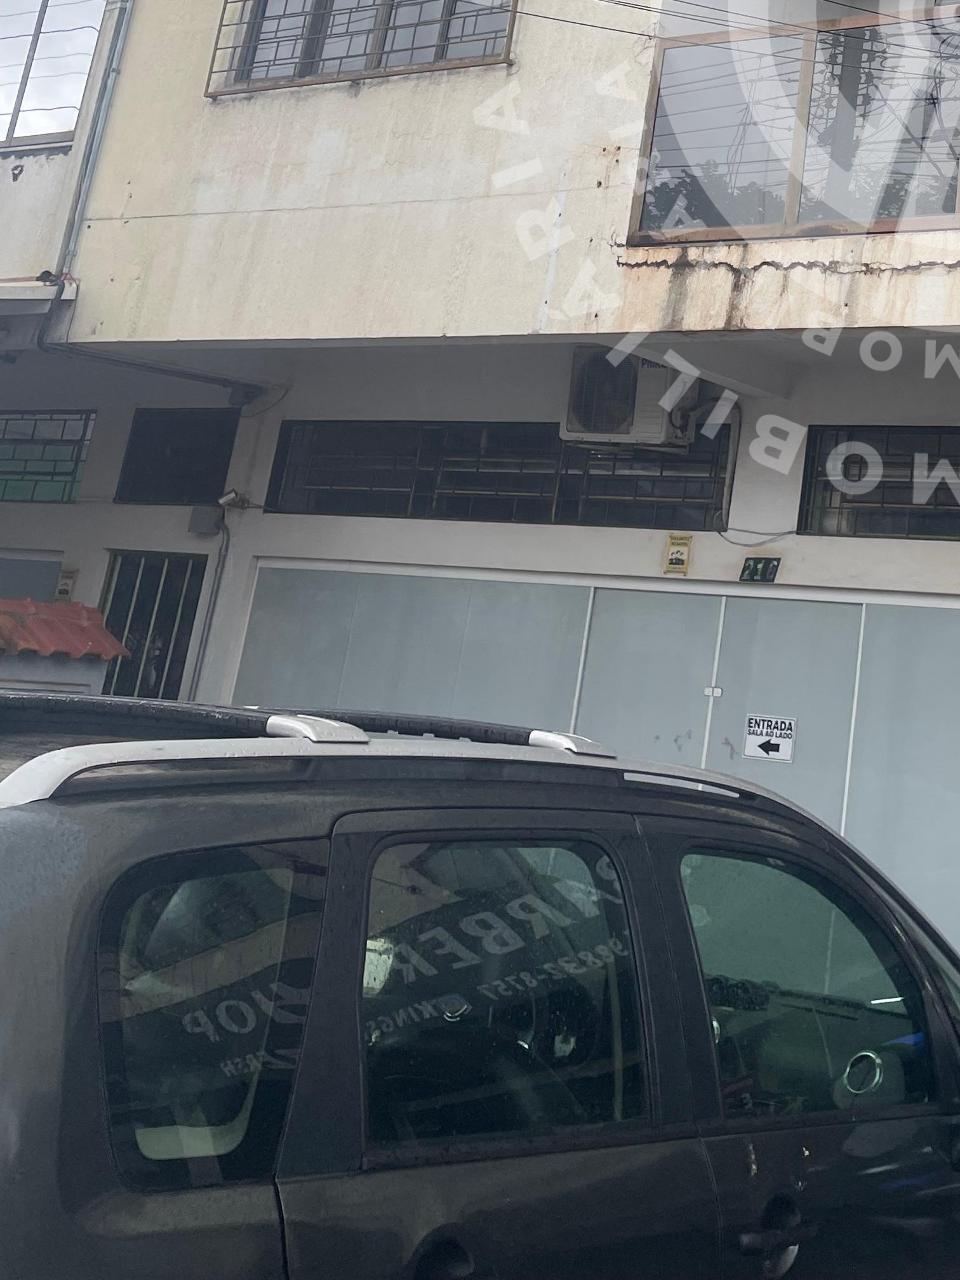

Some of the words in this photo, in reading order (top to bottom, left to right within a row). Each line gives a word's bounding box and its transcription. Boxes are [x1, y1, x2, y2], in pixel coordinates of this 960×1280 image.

[748, 717, 793, 732] ENTRADA
[747, 728, 763, 736] SALA
[775, 731, 793, 739] LADO
